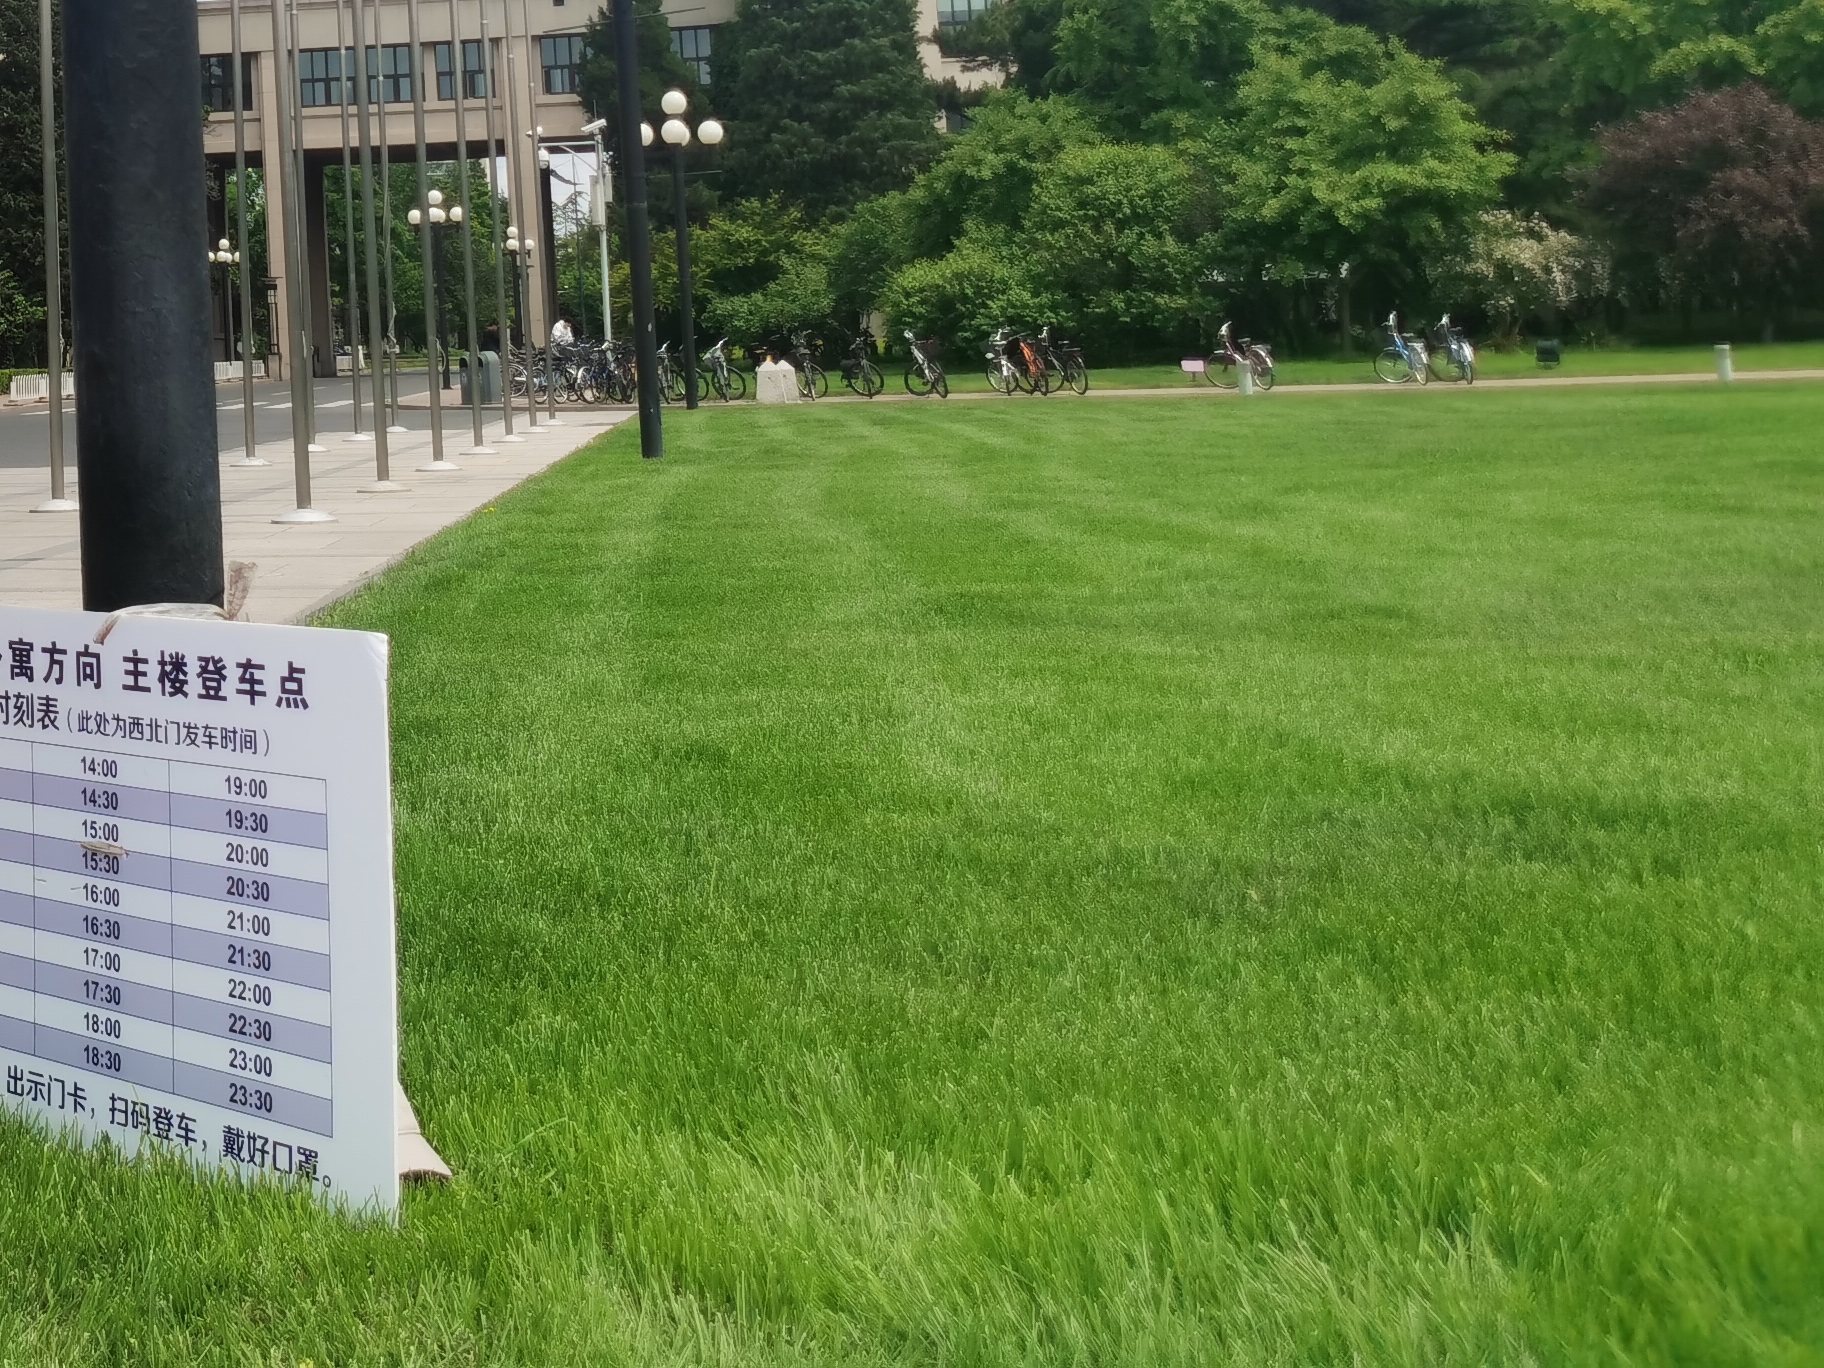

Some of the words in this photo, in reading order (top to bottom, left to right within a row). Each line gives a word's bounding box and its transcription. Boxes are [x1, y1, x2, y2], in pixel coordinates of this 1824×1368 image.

[122, 648, 310, 711] 主楼登车点
[80, 757, 118, 779] 14:00
[225, 775, 267, 799] 19:00
[81, 789, 118, 812] 14:30
[225, 809, 268, 834] 19:30
[81, 821, 118, 844] 15:00
[225, 844, 269, 869] 20:00
[81, 853, 119, 877] 15:30
[226, 878, 269, 904] 20:30
[82, 885, 119, 909] 16:00
[226, 912, 270, 939] 21:00
[82, 917, 120, 942] 16:30
[227, 946, 270, 974] 21:30
[82, 949, 120, 974] 17:00
[227, 981, 271, 1009] 22:00
[82, 981, 120, 1007] 17:30
[228, 1015, 272, 1044] 22:30
[83, 1013, 121, 1039] 18:00
[228, 1049, 272, 1078] 23:00
[83, 1045, 121, 1072] 18:30
[228, 1083, 273, 1113] 23:30
